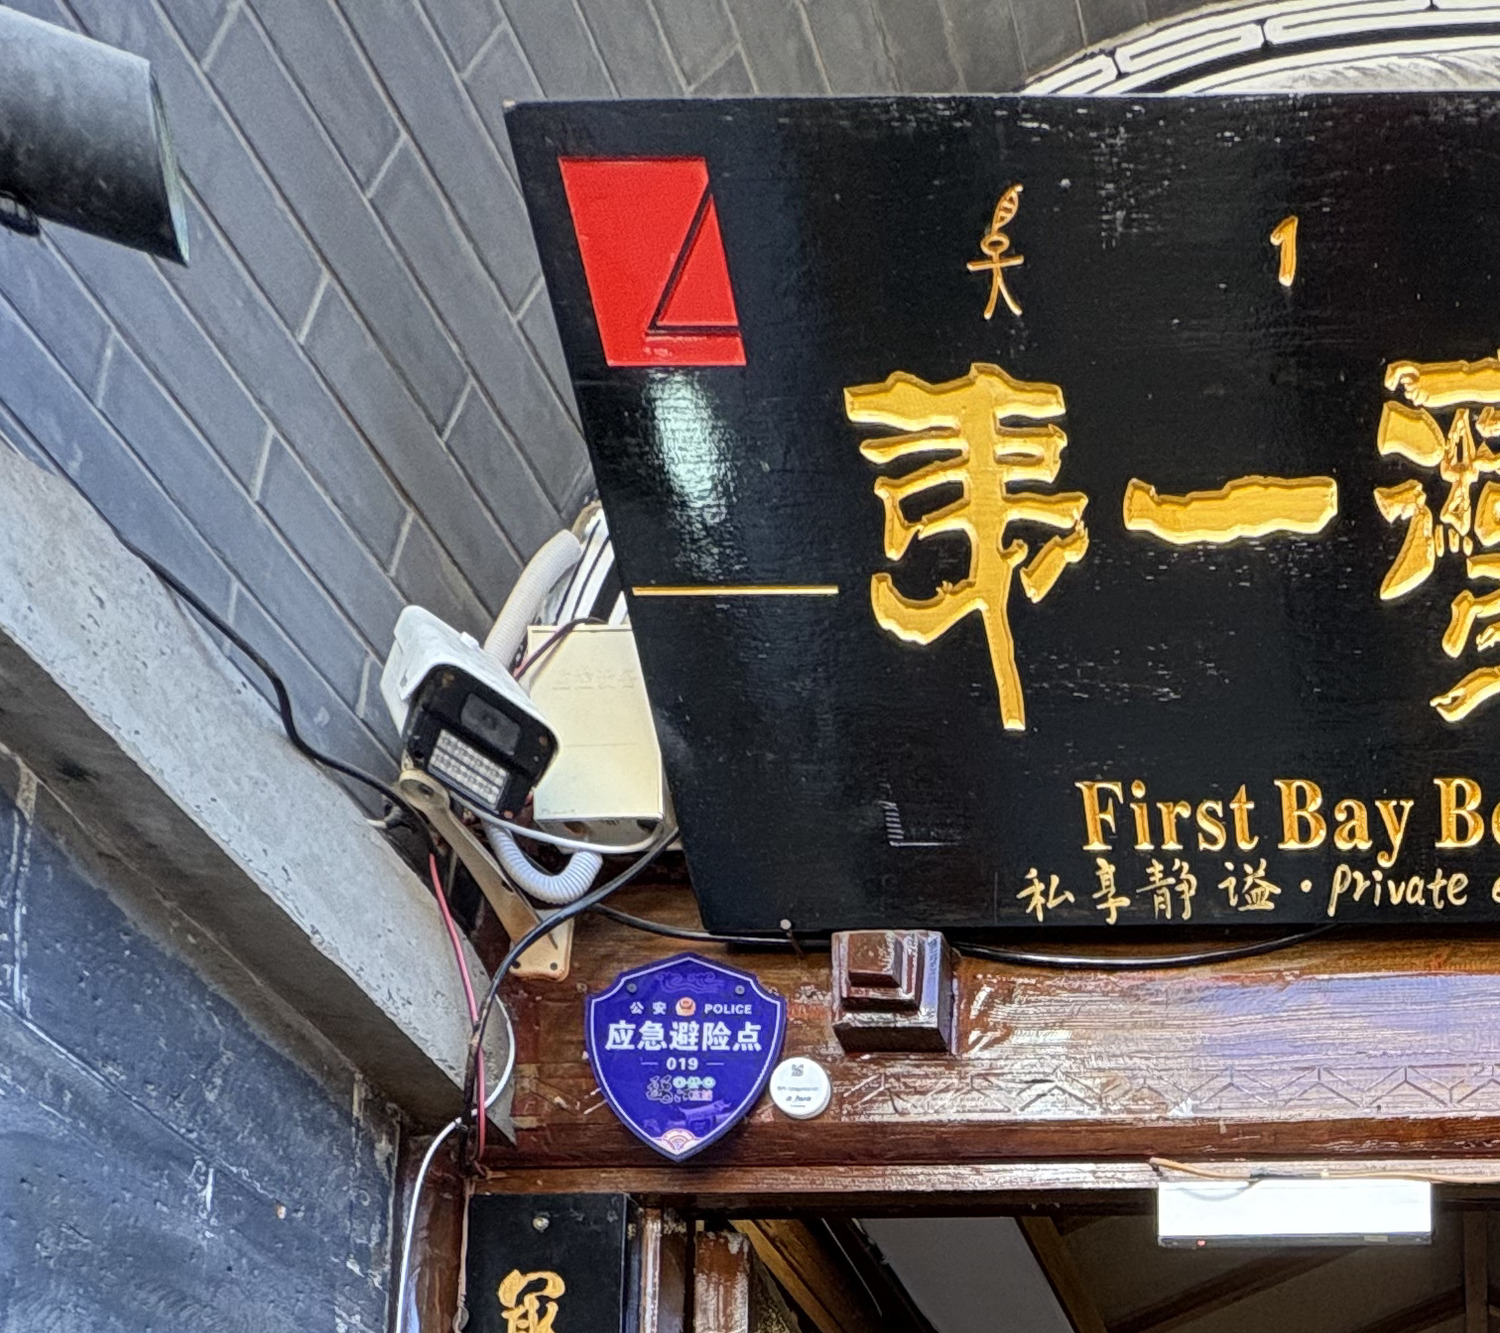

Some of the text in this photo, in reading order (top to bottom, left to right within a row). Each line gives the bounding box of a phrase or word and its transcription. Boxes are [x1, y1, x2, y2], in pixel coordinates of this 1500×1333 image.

[1075, 779, 1260, 852] First
[1273, 778, 1415, 869] Bay
[629, 1001, 753, 1016] 公安 POLICE
[604, 1019, 763, 1052] 应急避险点
[666, 1056, 699, 1071] 019
